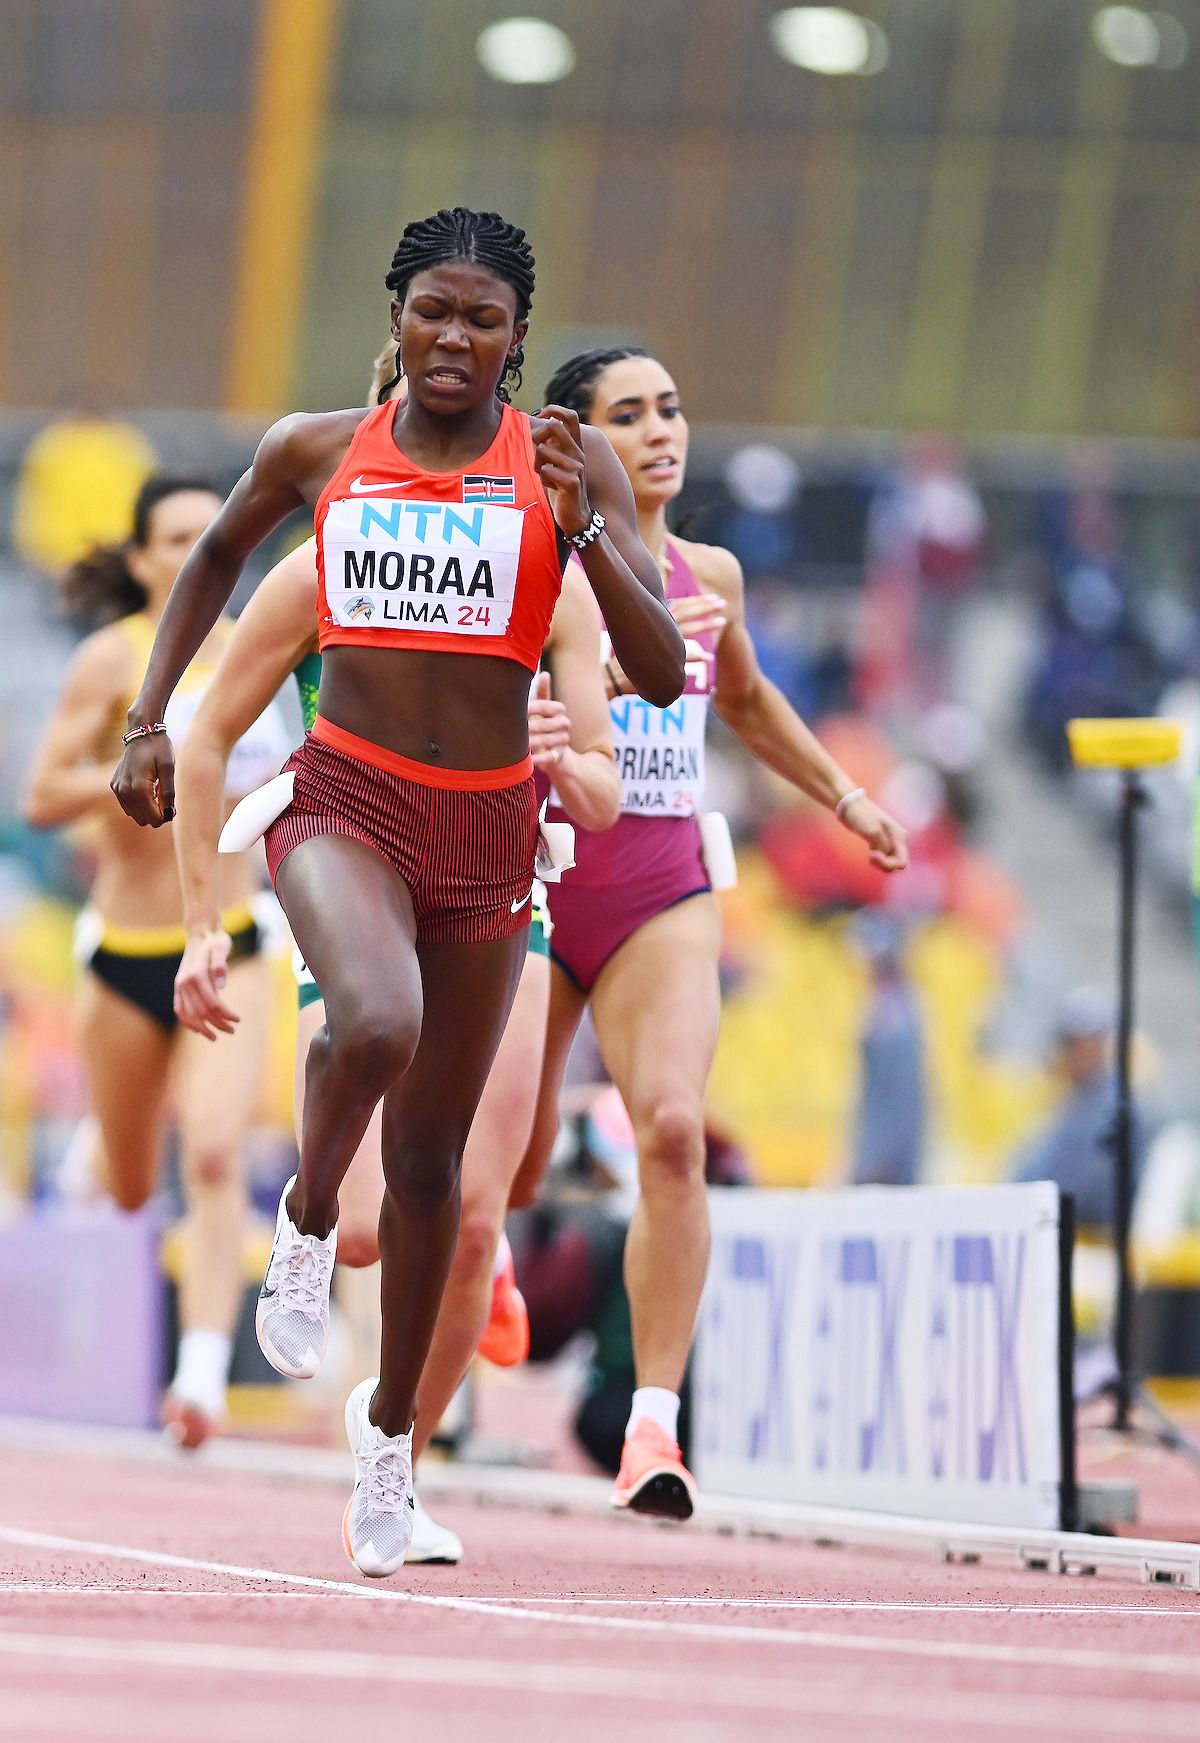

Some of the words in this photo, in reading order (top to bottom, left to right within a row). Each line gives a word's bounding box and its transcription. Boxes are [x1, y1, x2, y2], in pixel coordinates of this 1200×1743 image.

[360, 501, 484, 547] NTN
[344, 550, 495, 599] MORAA
[383, 599, 449, 625] LIMA
[457, 605, 491, 627] 24
[621, 790, 666, 808] IMA
